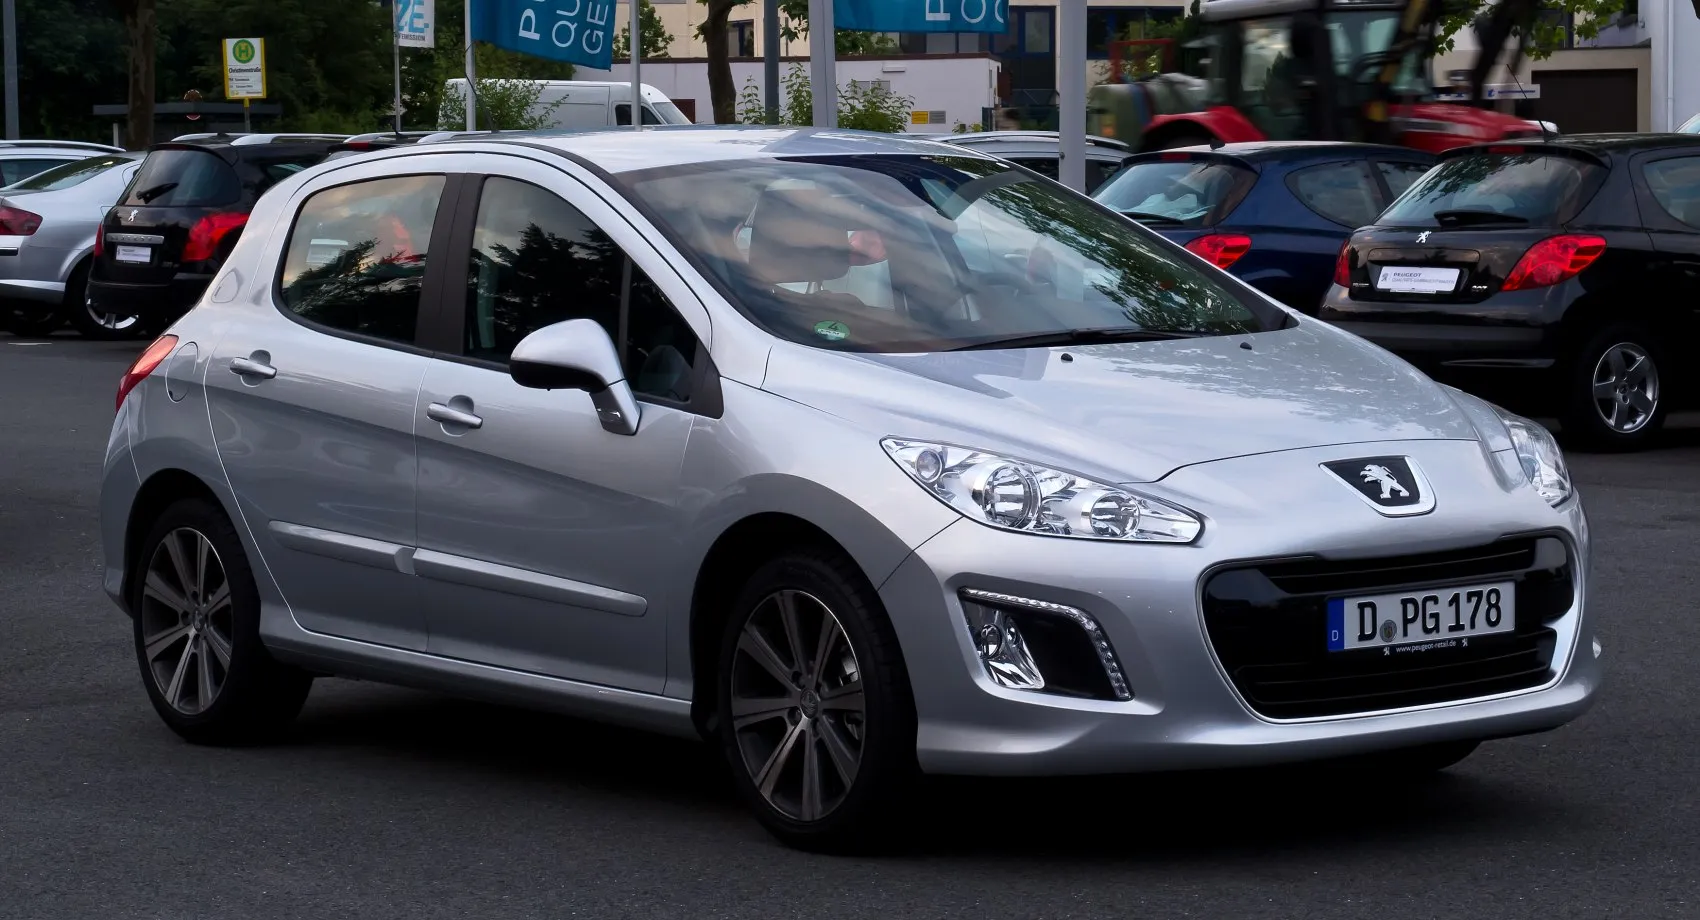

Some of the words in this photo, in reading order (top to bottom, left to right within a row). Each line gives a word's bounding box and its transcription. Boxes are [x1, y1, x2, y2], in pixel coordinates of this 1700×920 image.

[582, 1, 609, 54] GE
[239, 44, 248, 58] H
[1357, 601, 1377, 641] D
[1400, 595, 1440, 638] PG
[1448, 587, 1502, 633] 178
[1331, 630, 1339, 642] D
[1395, 640, 1457, 653] www.peugeot-retail.de
